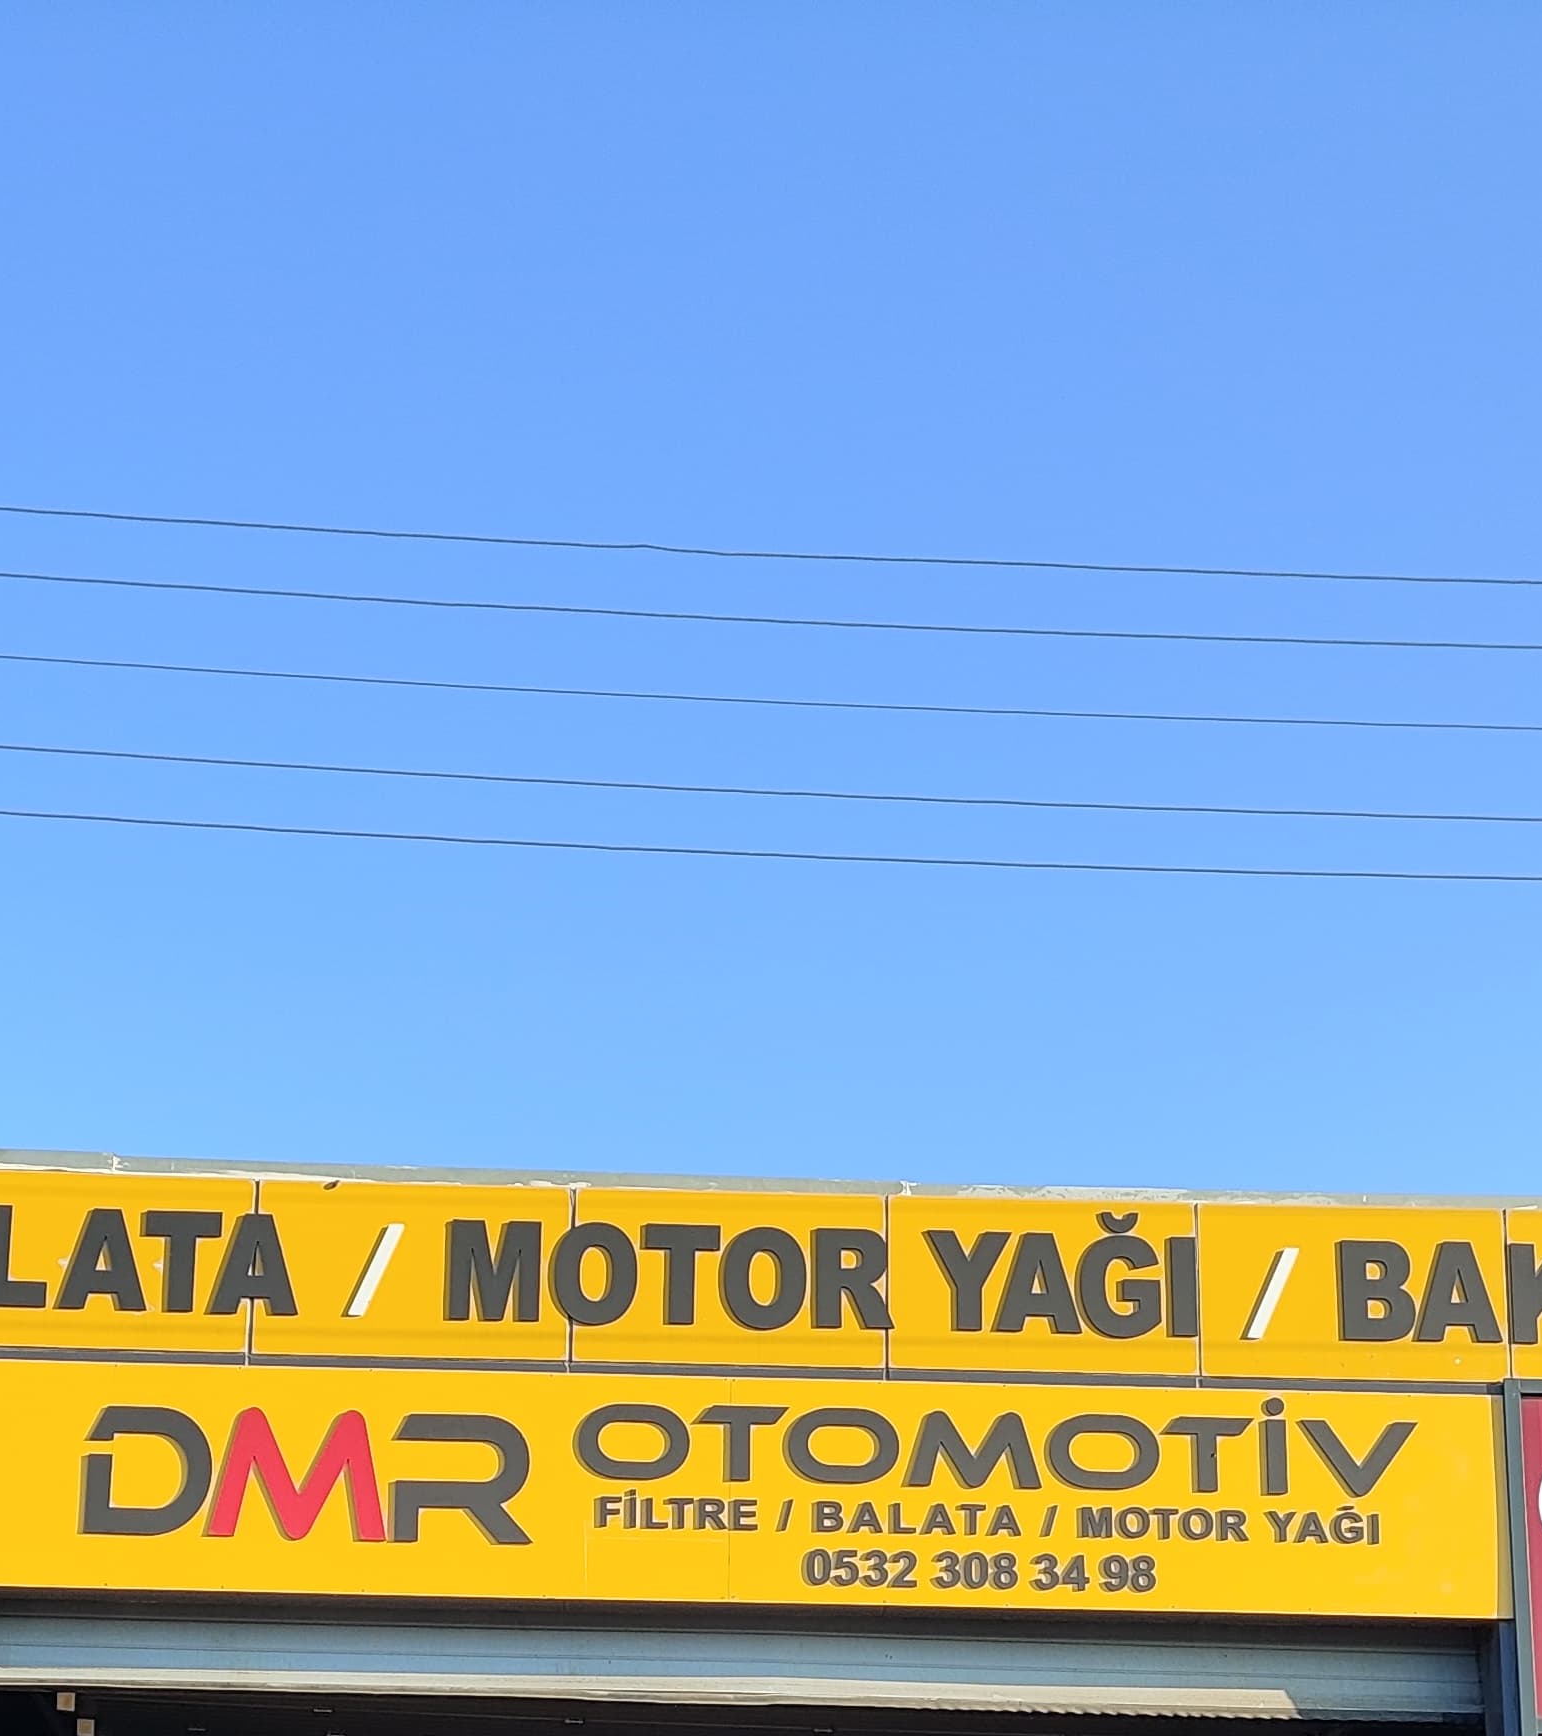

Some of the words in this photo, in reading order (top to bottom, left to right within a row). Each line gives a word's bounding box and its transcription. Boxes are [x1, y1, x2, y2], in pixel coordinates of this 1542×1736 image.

[342, 1223, 404, 1318] /
[442, 1218, 895, 1331] MOTOR
[921, 1212, 1199, 1339] YAĞI
[1239, 1247, 1299, 1342] /
[77, 1405, 533, 1546] DMR
[572, 1397, 1419, 1498] OTOMOTİV
[592, 1488, 759, 1531] FİLTRE
[776, 1499, 793, 1531] /
[811, 1500, 1021, 1537] BALATA
[1039, 1505, 1059, 1537] /
[1075, 1507, 1248, 1542] MOTOR
[1264, 1505, 1381, 1545] YAĞI
[801, 1549, 918, 1589] 0532
[930, 1551, 1018, 1591] 308
[1029, 1553, 1090, 1592] 34
[1099, 1554, 1157, 1593] 98
